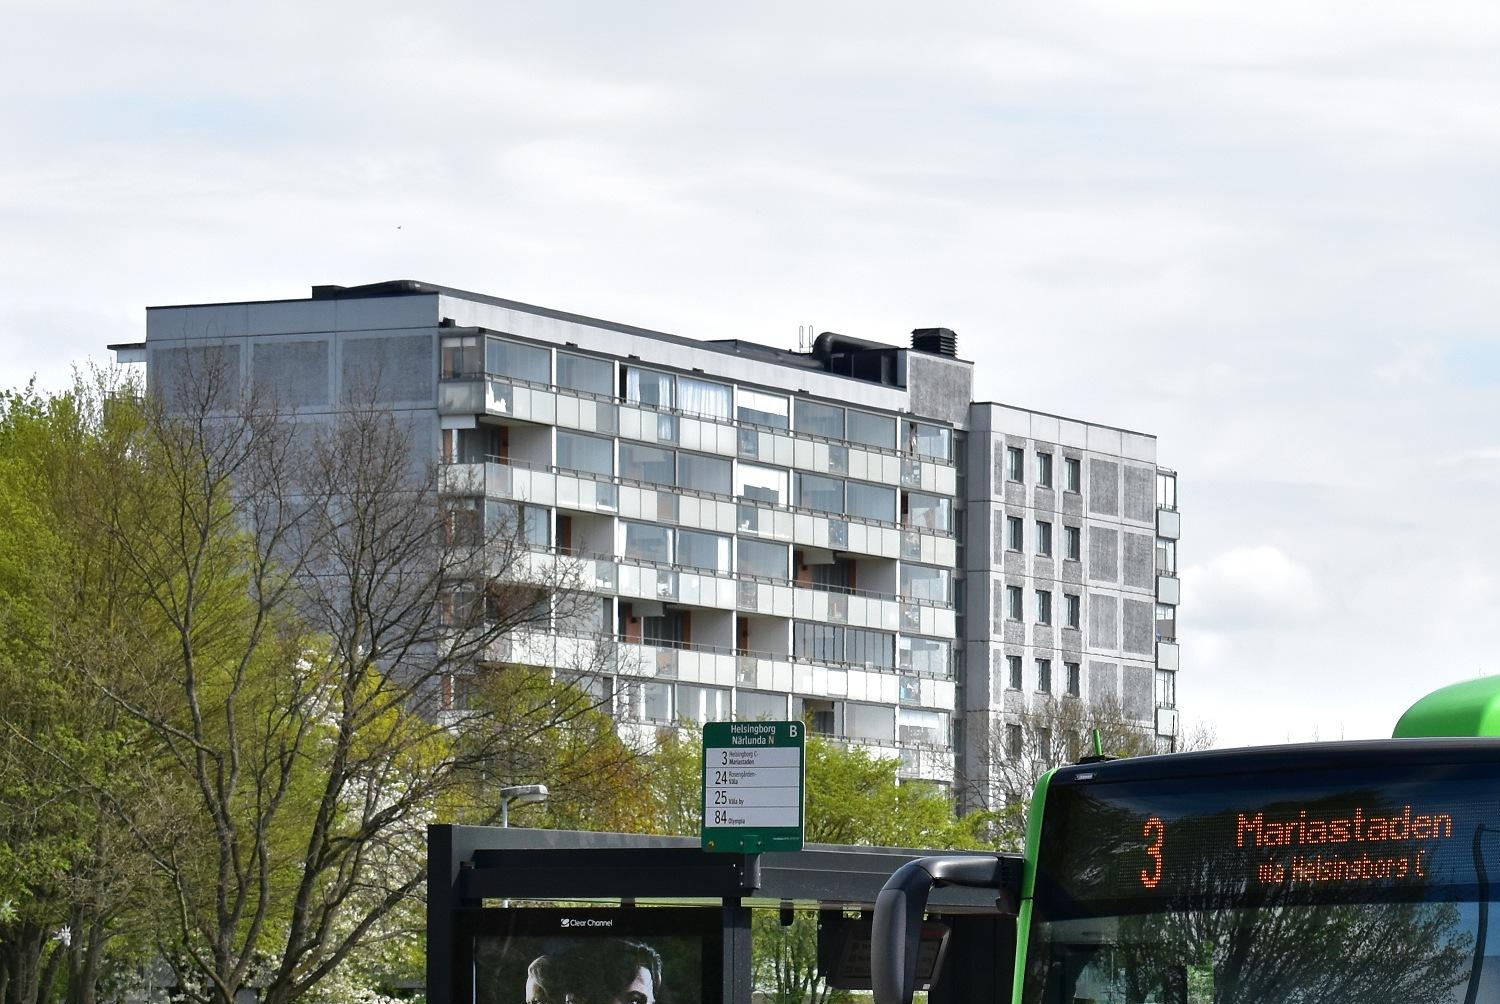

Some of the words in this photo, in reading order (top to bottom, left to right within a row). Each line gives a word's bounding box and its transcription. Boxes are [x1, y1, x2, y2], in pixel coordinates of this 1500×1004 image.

[731, 725, 776, 735] Helsingborg
[789, 725, 798, 737] B
[732, 736, 766, 745] Närlunda
[768, 736, 775, 745] N
[721, 751, 728, 766] 3
[715, 770, 728, 785] 24
[714, 790, 727, 805] 25
[714, 810, 727, 824] 84
[1237, 804, 1453, 847] Mariastaden
[1141, 816, 1164, 889] 3
[570, 919, 586, 927] Clear
[587, 919, 613, 927] Channel
